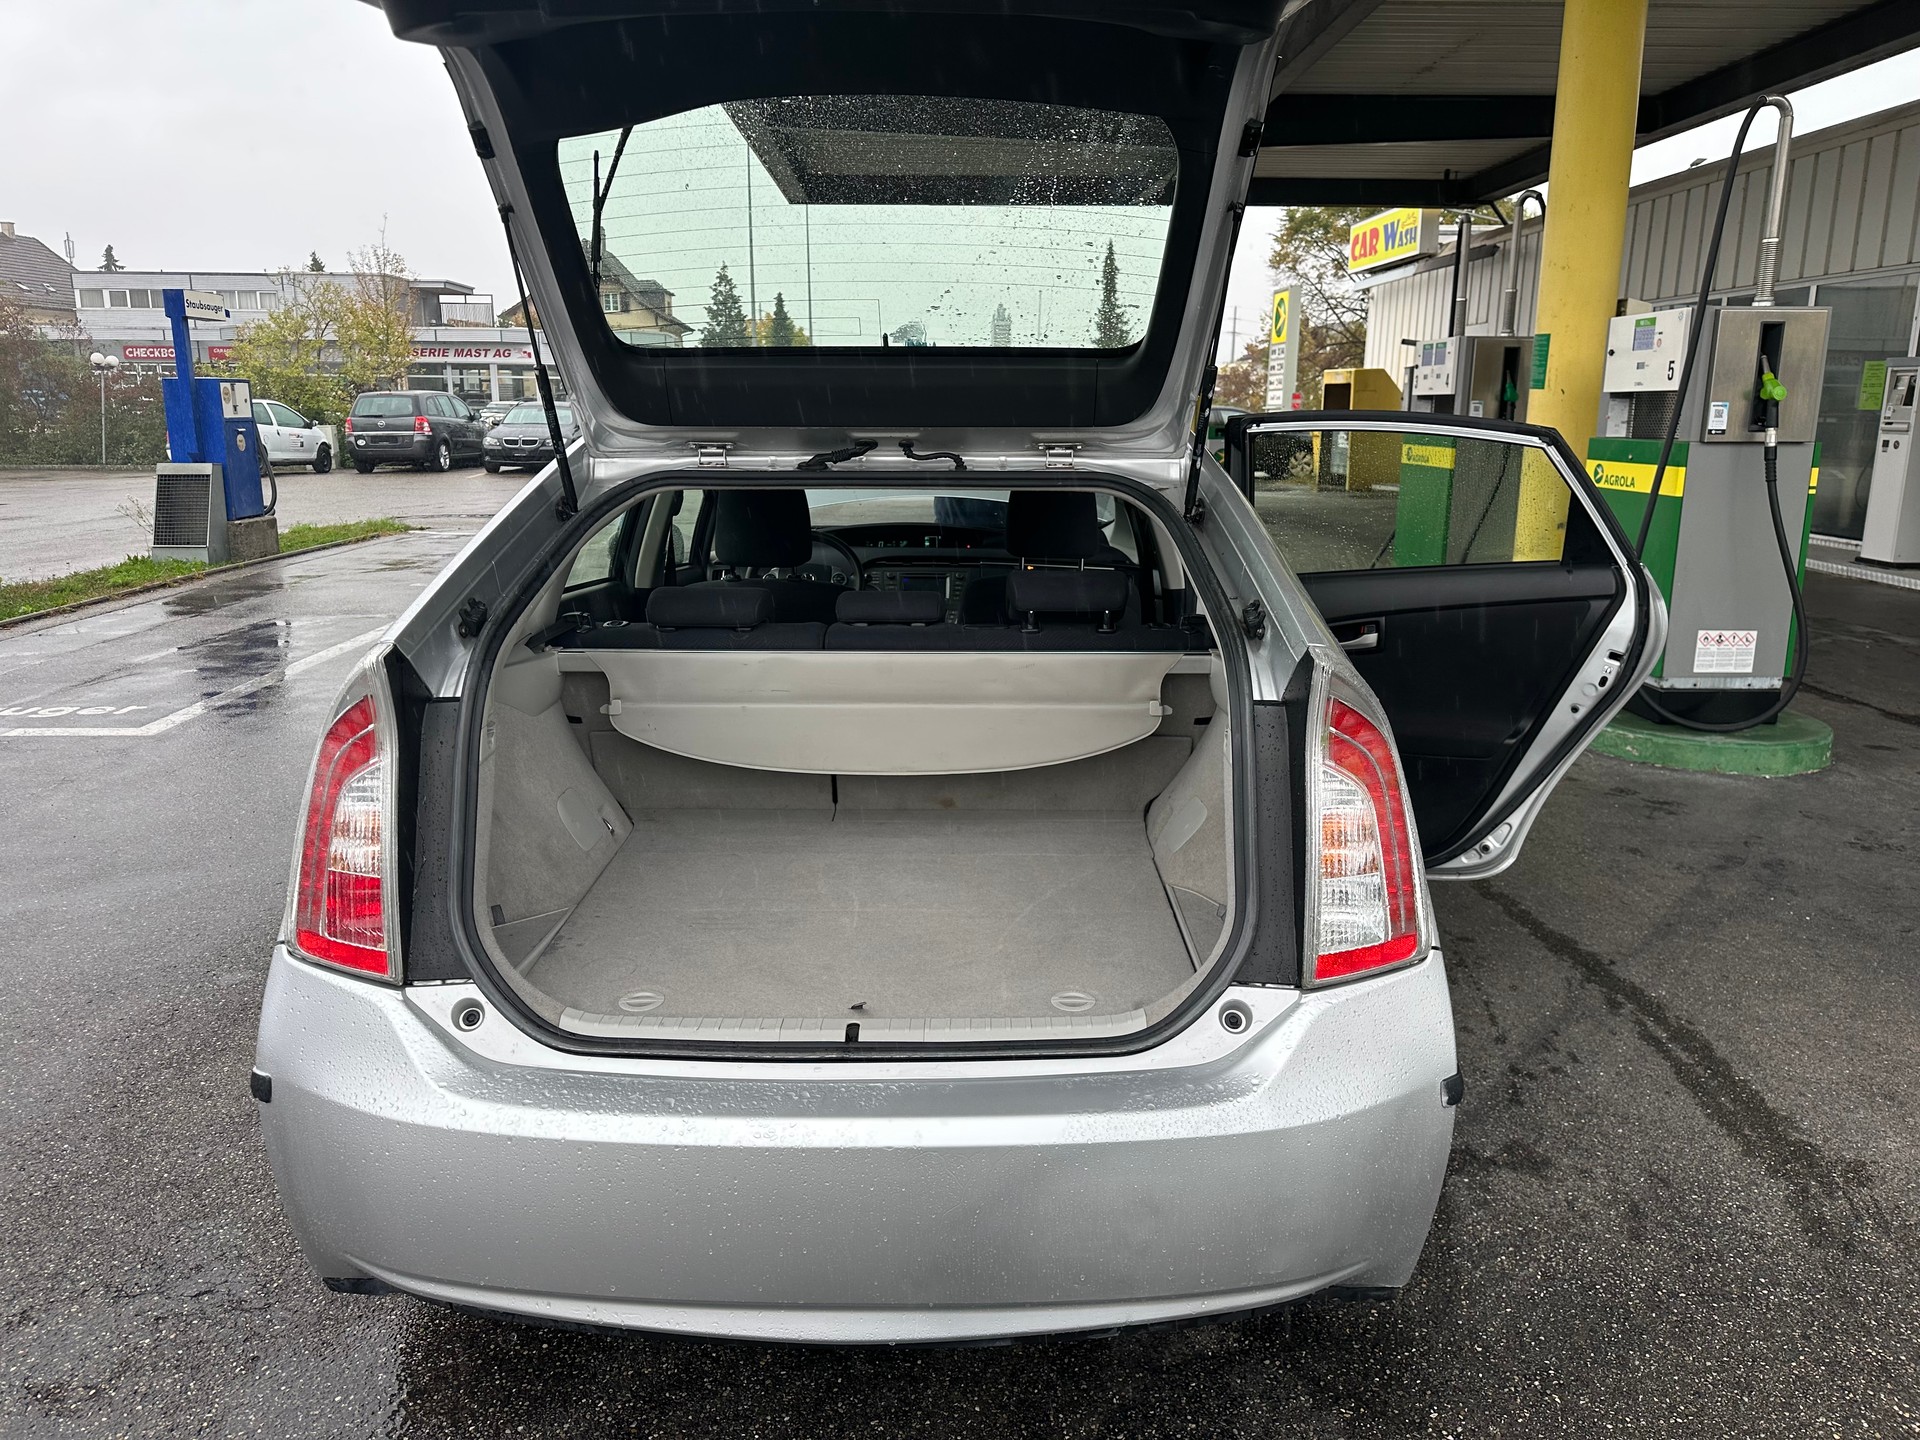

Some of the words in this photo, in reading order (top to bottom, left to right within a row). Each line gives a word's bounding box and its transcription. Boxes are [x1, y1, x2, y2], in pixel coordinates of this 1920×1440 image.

[1351, 227, 1379, 262] CAR
[185, 298, 224, 315] Staubsauger
[125, 347, 176, 358] CHECKBO
[411, 347, 450, 358] SERIE
[453, 348, 491, 358] MAST
[493, 348, 512, 358] AG
[1667, 360, 1676, 381] 5
[1603, 474, 1636, 488] AGROLA
[0, 705, 148, 718] uger
